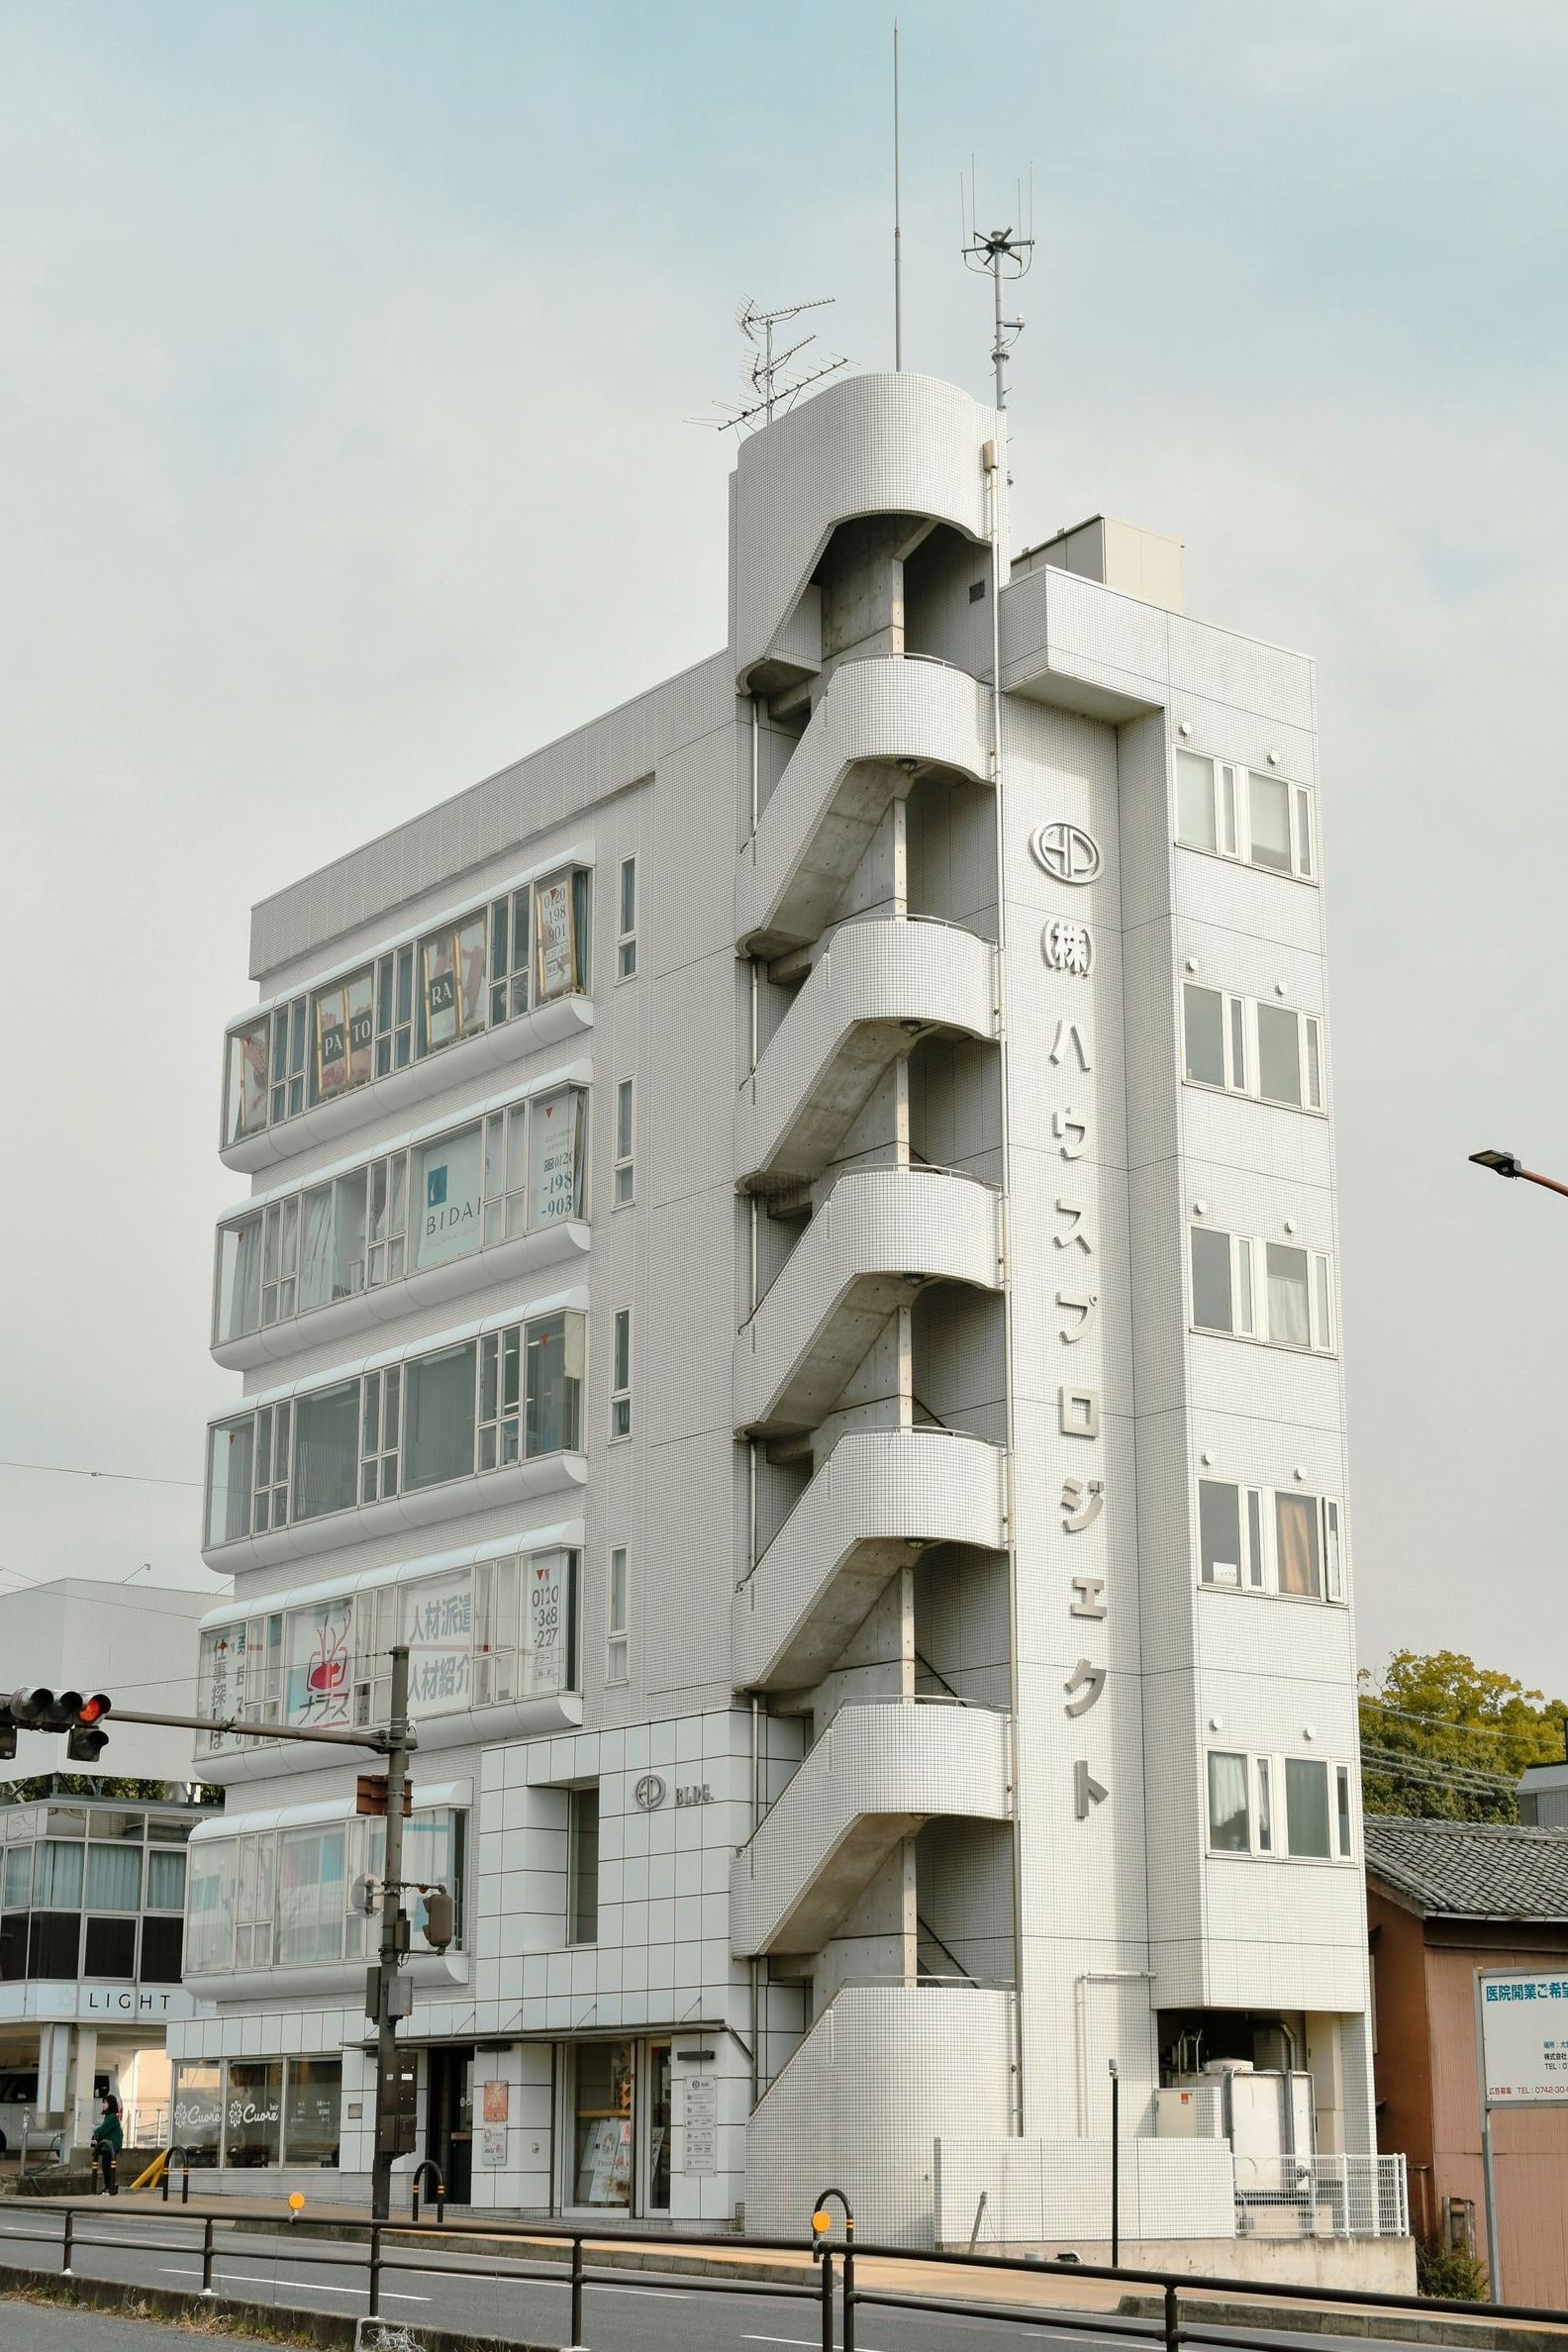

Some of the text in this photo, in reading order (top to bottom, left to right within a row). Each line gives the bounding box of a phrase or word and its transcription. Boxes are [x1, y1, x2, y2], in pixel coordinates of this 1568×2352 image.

[432, 982, 452, 1006] RA
[426, 1197, 481, 1236] BIDAI
[533, 1585, 559, 1608] 0120
[408, 1652, 470, 1702] 人材紹介
[89, 1992, 171, 2010] LIGHT
[187, 2105, 222, 2125] Cuore
[243, 2103, 279, 2124] Cuore
